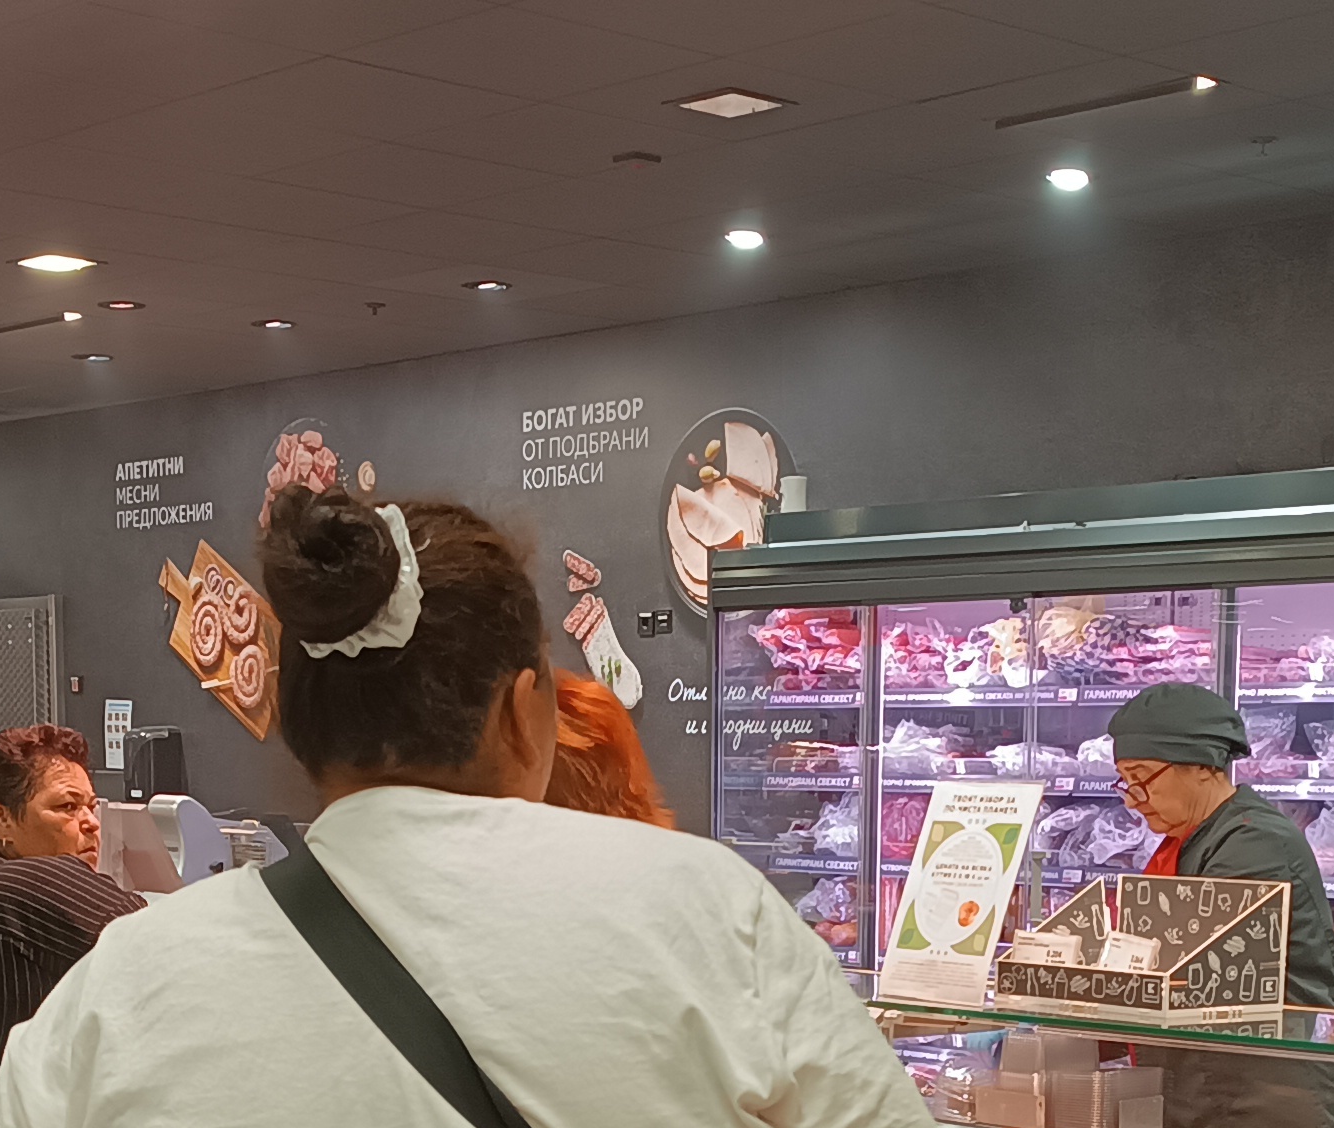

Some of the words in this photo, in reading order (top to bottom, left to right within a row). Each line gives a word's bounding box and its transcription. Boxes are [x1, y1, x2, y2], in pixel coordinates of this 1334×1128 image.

[522, 406, 577, 433] БОГАТ
[581, 397, 644, 426] ИЗБОР
[522, 438, 545, 461] ОТ
[549, 426, 649, 460] ПОДБРАНИ
[115, 456, 184, 481] АПЕТИТНИ
[522, 461, 603, 490] КОЛБАСИ
[116, 483, 160, 505] МЕСНИ
[116, 502, 213, 530] ПРЕДЛОЖЕНИЯ
[668, 678, 746, 702] Отлно
[1084, 689, 1140, 699] ГАРАНТИРАН
[770, 719, 814, 741] цени
